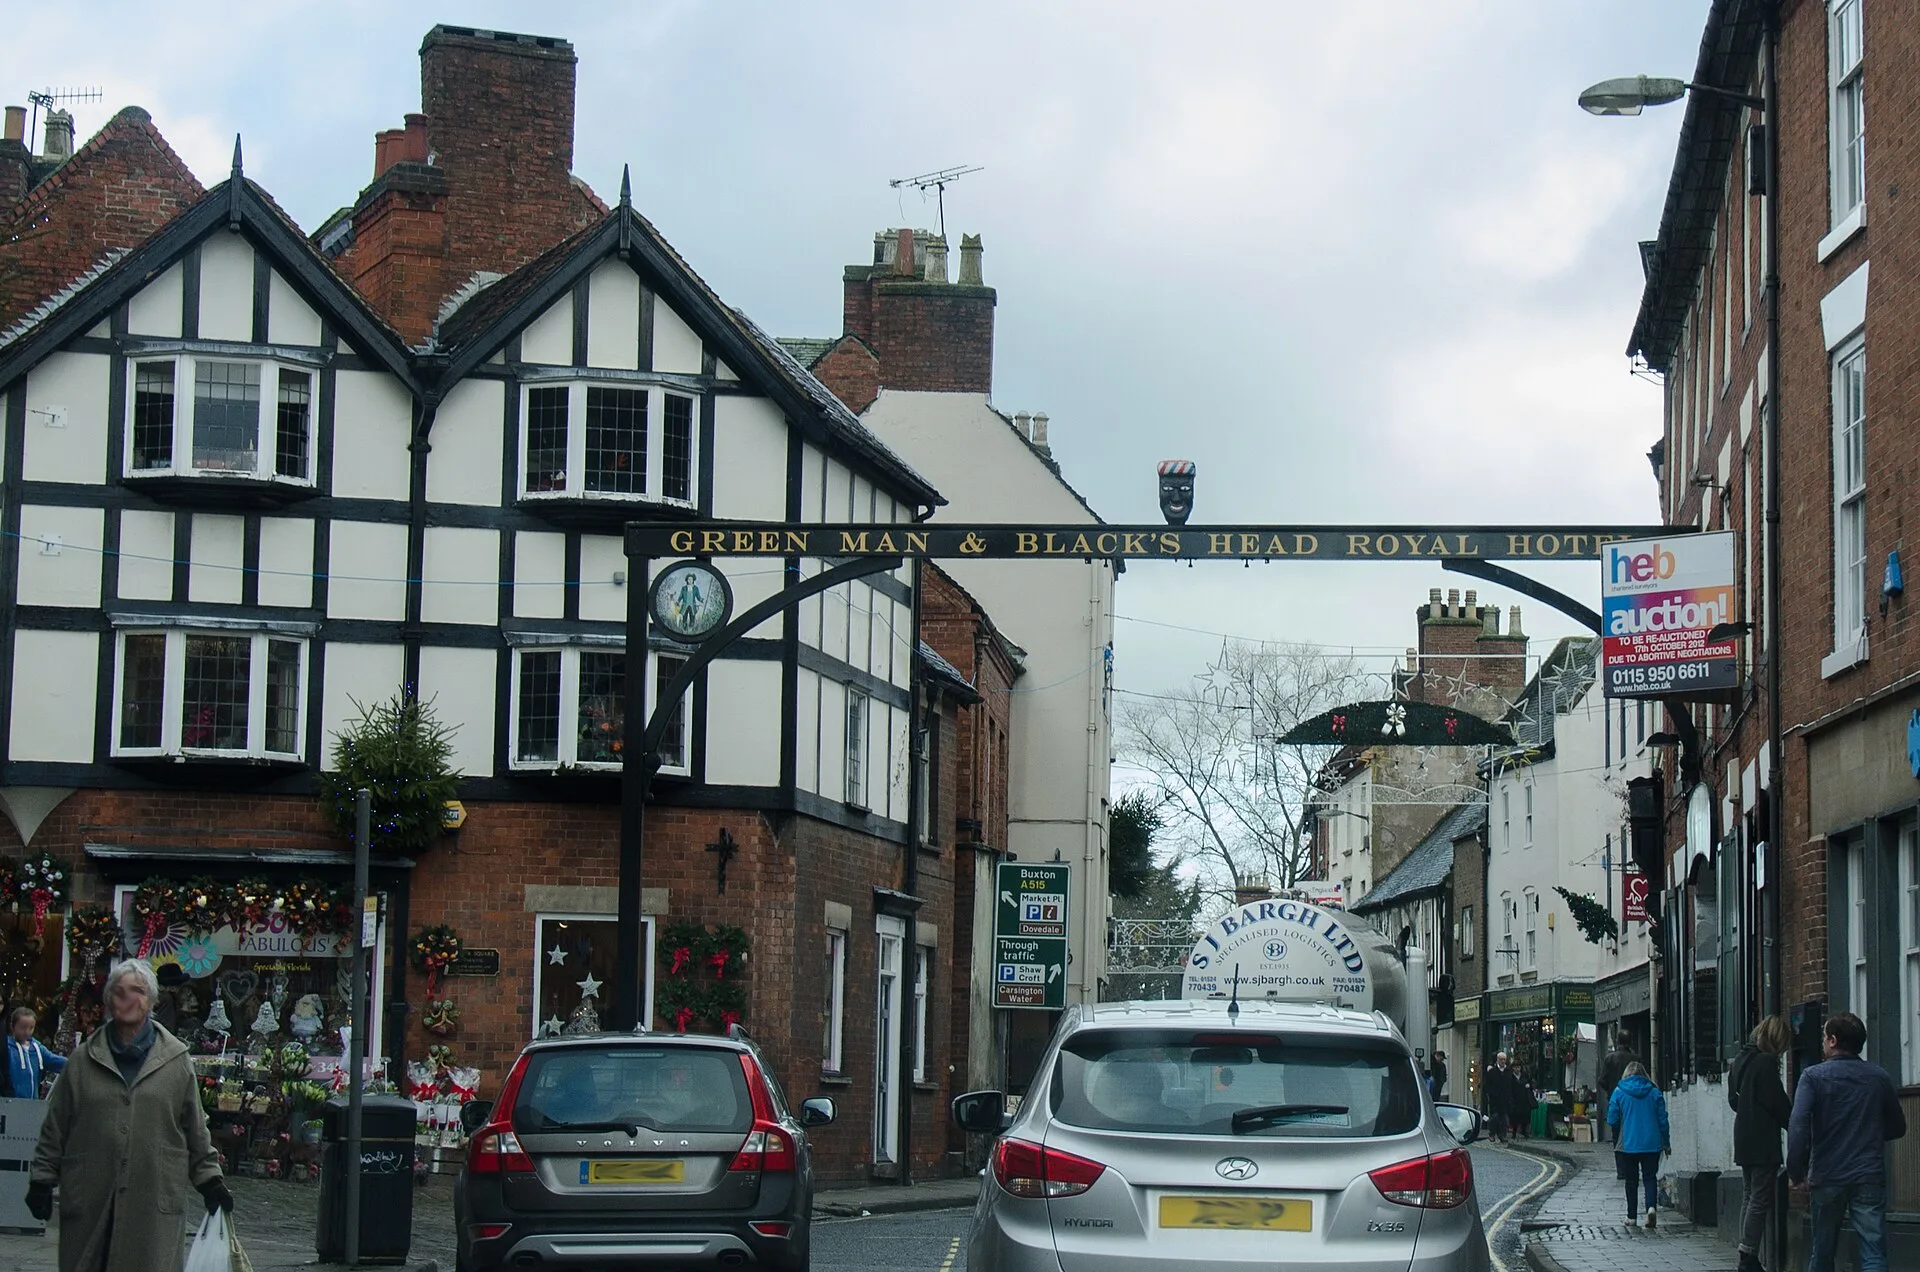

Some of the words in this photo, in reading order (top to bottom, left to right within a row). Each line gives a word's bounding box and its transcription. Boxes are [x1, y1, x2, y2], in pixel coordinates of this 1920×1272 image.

[670, 531, 811, 552] GREEN
[840, 532, 931, 553] MAN
[959, 532, 987, 554] &
[1015, 532, 1181, 555] BLACK'S
[1207, 533, 1318, 555] HEAD
[1346, 534, 1478, 556] ROYAL
[1506, 534, 1633, 556] HOTE
[1611, 543, 1675, 584] heb
[1610, 593, 1727, 635] auction!
[1619, 637, 1631, 646] TO
[1632, 636, 1644, 645] BE
[1645, 631, 1706, 644] RE-AUCTIONED
[1634, 645, 1649, 653] 17th
[1650, 642, 1687, 652] OCTOBER
[1688, 640, 1705, 649] 2012
[1608, 655, 1624, 664] DUE
[1626, 654, 1637, 663] TO
[1638, 651, 1676, 661] ABORTIVE
[1677, 646, 1731, 659] NEGOTIATIONS
[1613, 668, 1645, 685] 0115
[1648, 665, 1676, 682] 950
[1678, 662, 1710, 679] 6611
[1613, 681, 1671, 693] www.heb.co.uk
[1020, 869, 1056, 879] Buxton
[1020, 880, 1045, 889] A515
[1021, 894, 1050, 903] Market
[1022, 925, 1060, 934] Dovedale
[1220, 902, 1322, 937] BARGH
[1322, 921, 1364, 975] LTD
[1000, 940, 1039, 951] Through
[1215, 928, 1279, 966] SPECIALISED
[1284, 929, 1337, 967] LOGISTICS
[1003, 951, 1035, 961] traffic
[1019, 966, 1042, 974] Shaw
[1019, 974, 1041, 982] Croft
[1224, 975, 1325, 987] www.sjbargh.co.uk
[999, 985, 1043, 996] Carsington
[1188, 983, 1217, 991] 770439
[1332, 985, 1366, 993] 770487
[1008, 994, 1033, 1003] Water
[577, 1139, 689, 1147] VOLVO
[1064, 1218, 1113, 1228] HYUNDAI
[1367, 1219, 1405, 1232] ix35
